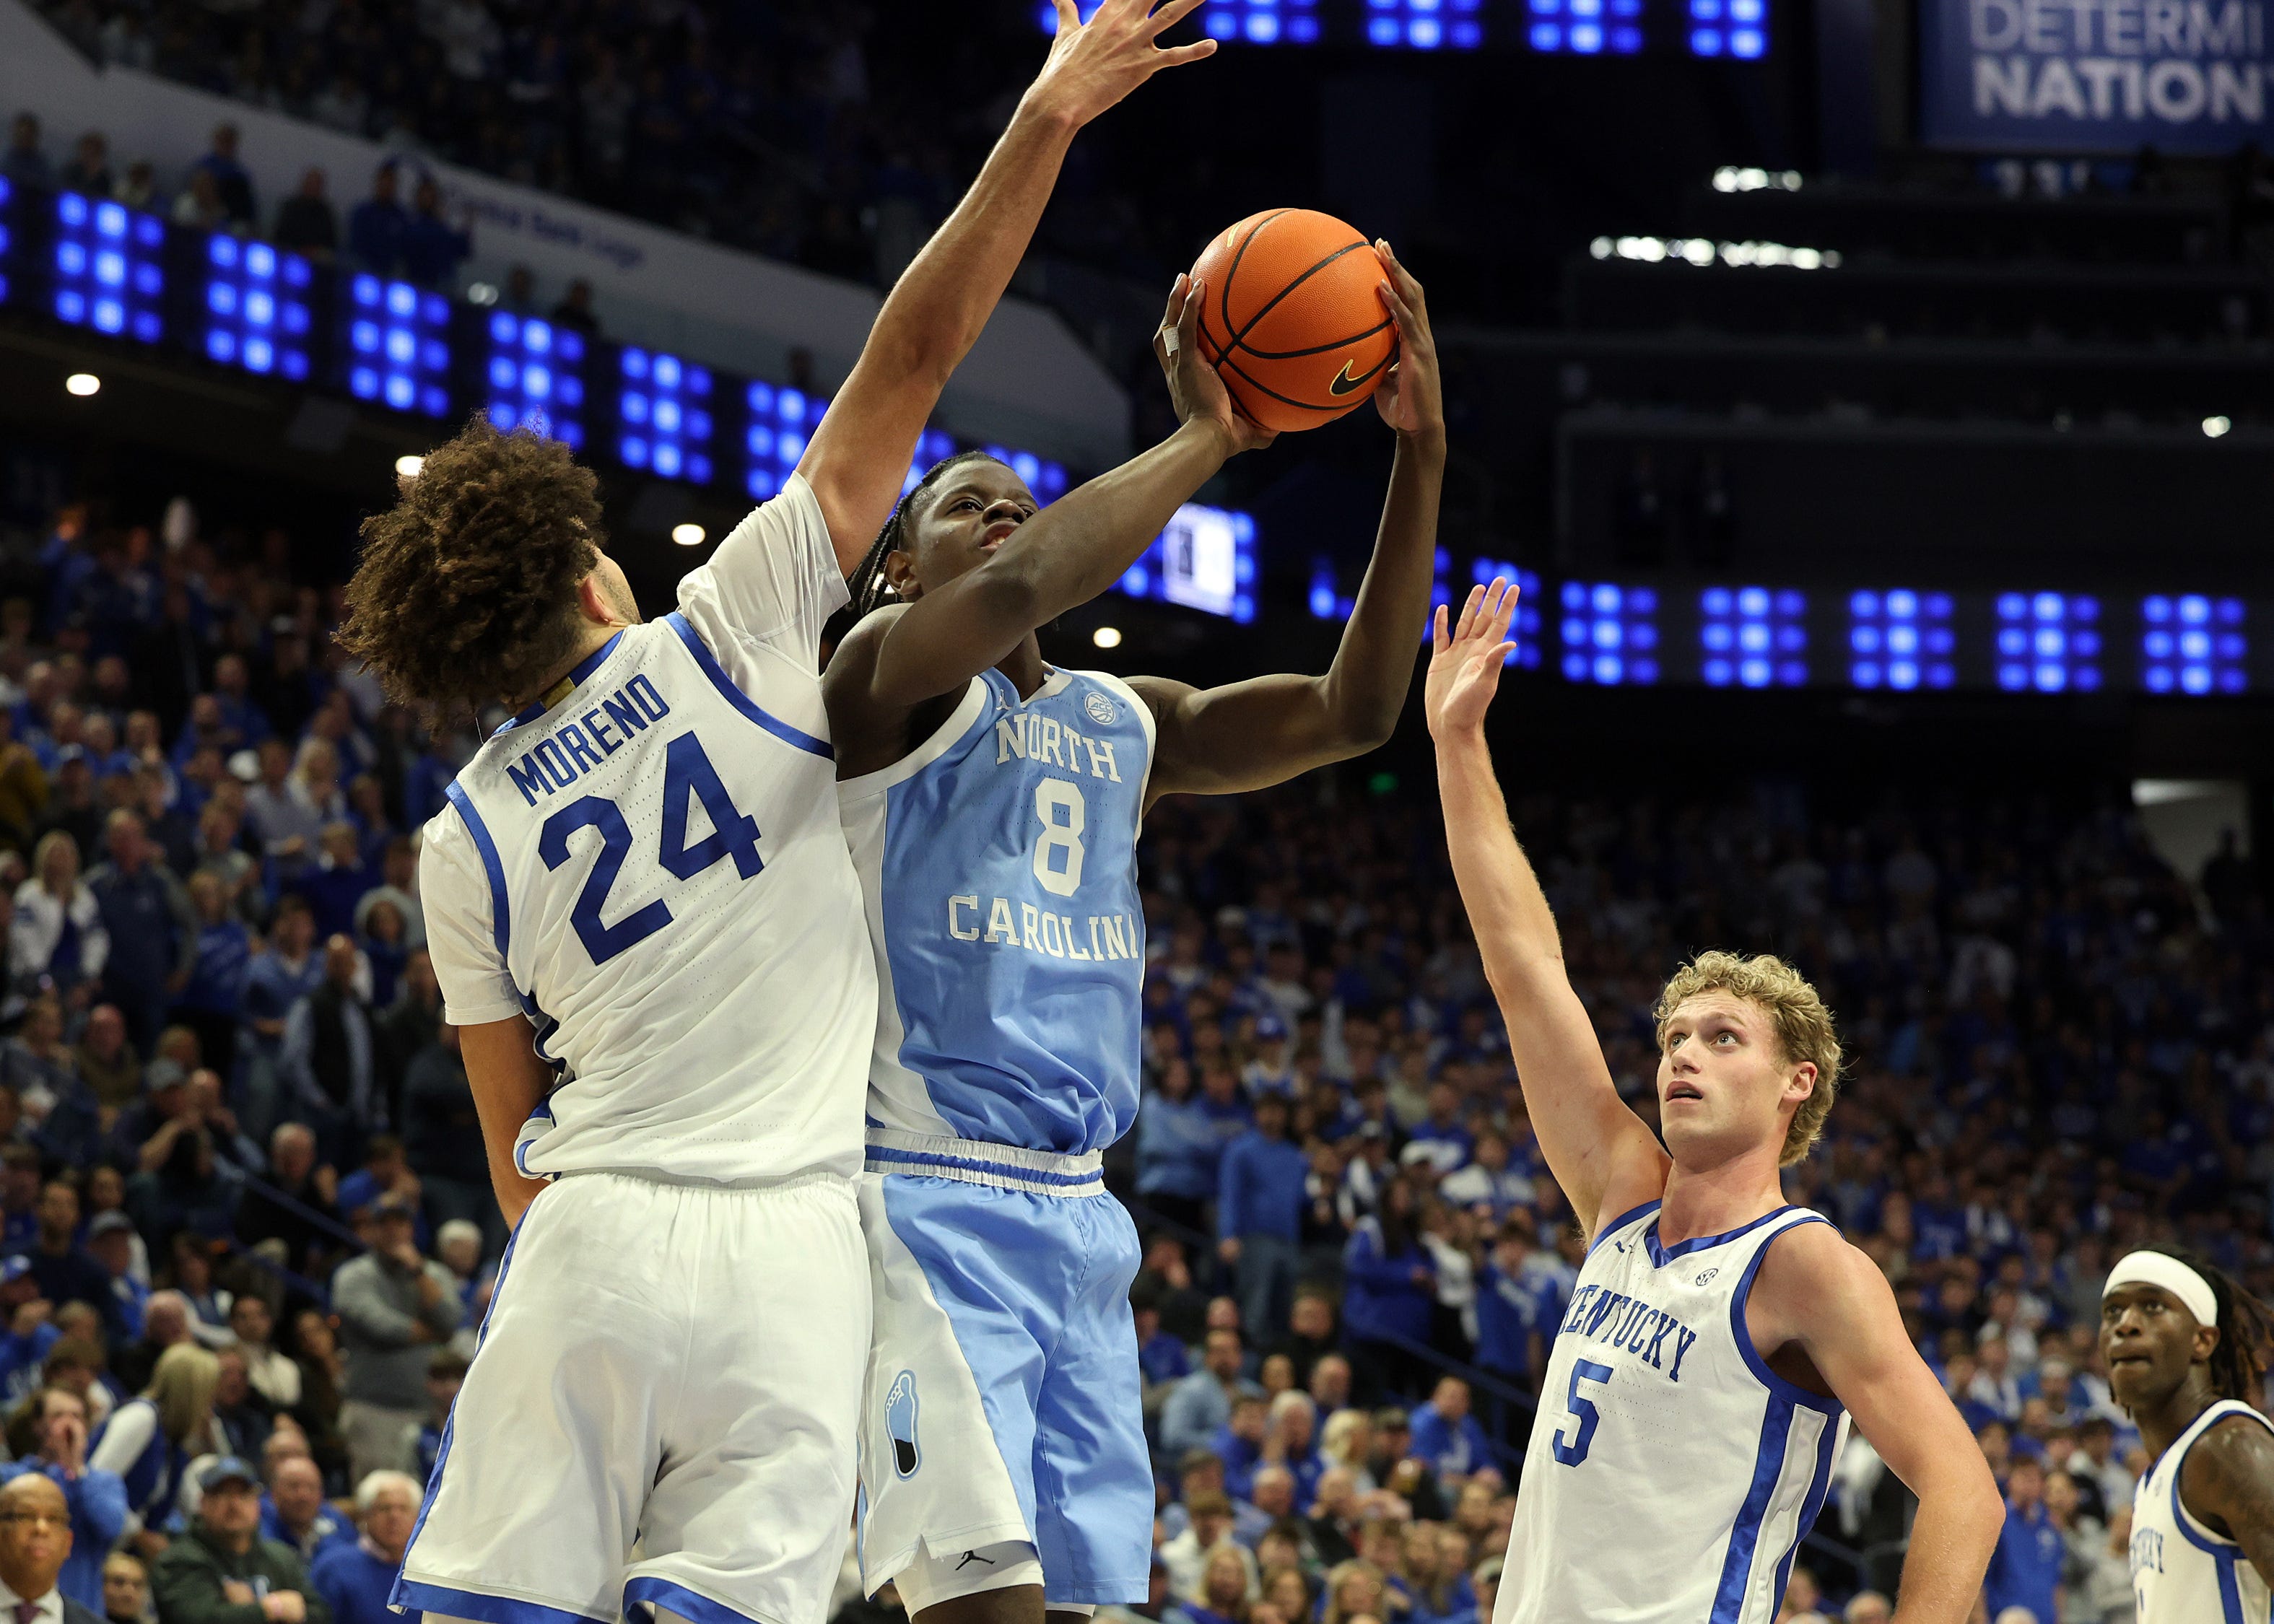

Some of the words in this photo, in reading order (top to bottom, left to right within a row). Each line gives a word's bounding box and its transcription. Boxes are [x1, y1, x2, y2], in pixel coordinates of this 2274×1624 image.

[505, 673, 671, 808] MORENO
[995, 712, 1123, 784] NORTH
[538, 730, 765, 966] 24
[1032, 777, 1086, 898] 8
[1696, 1269, 1718, 1285] SEC
[1551, 1358, 1614, 1468] 5
